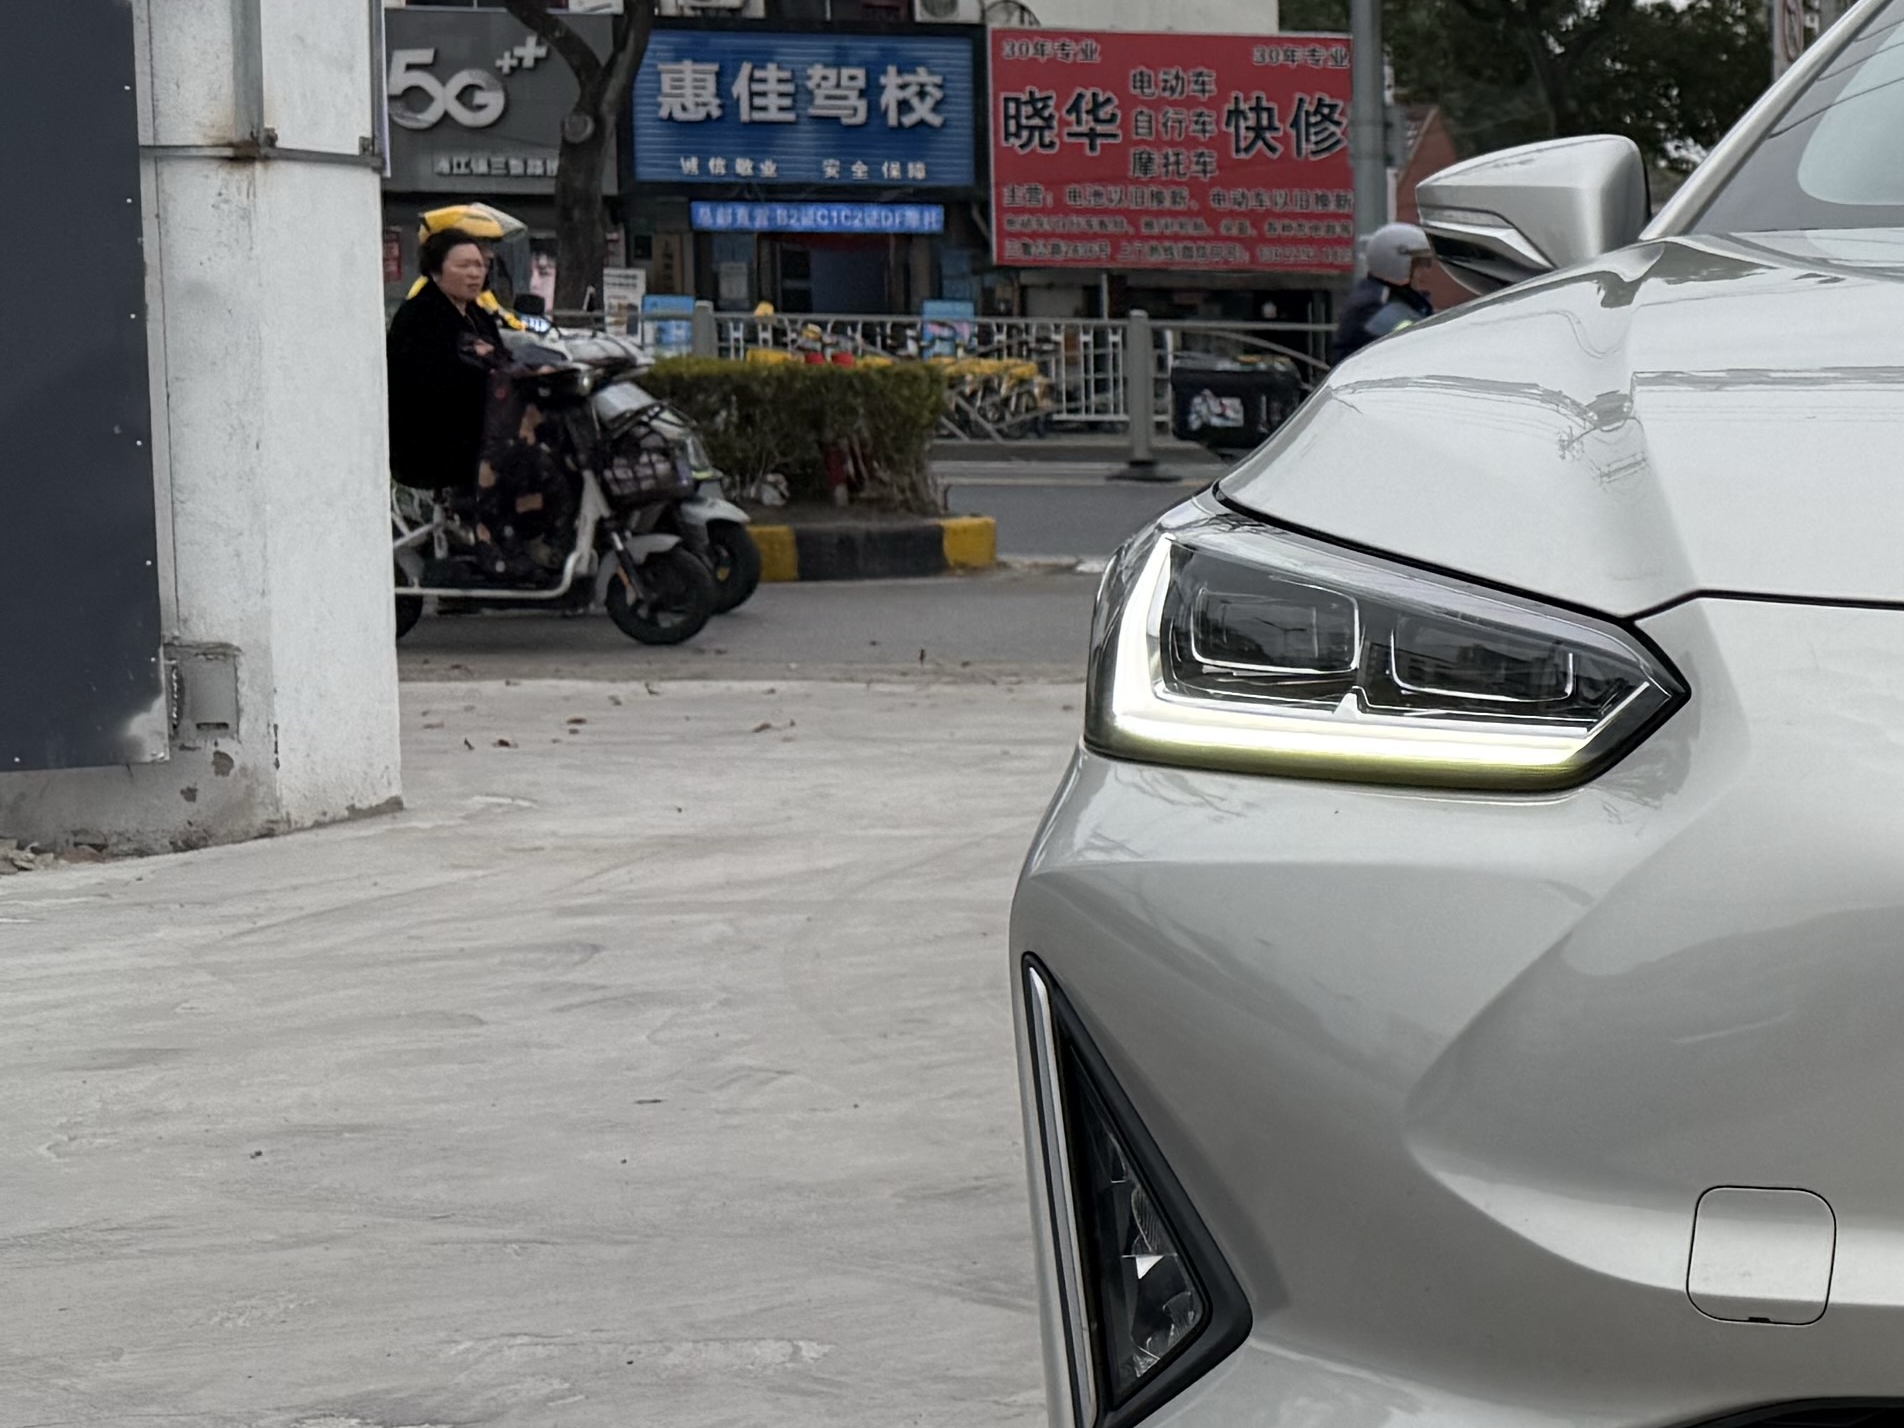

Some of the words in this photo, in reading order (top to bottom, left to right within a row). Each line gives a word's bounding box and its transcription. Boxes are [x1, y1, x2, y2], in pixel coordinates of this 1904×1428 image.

[1003, 41, 1100, 63] 30年专业
[1252, 46, 1350, 69] 30年专业
[657, 60, 945, 128] 惠佳驾校
[1130, 67, 1217, 99] 电动车
[1001, 86, 1121, 156] 晓华
[1225, 90, 1349, 160] 快修
[1131, 107, 1218, 140] 自行车
[822, 159, 927, 180] 安全保障
[1129, 147, 1219, 181] 摩托车
